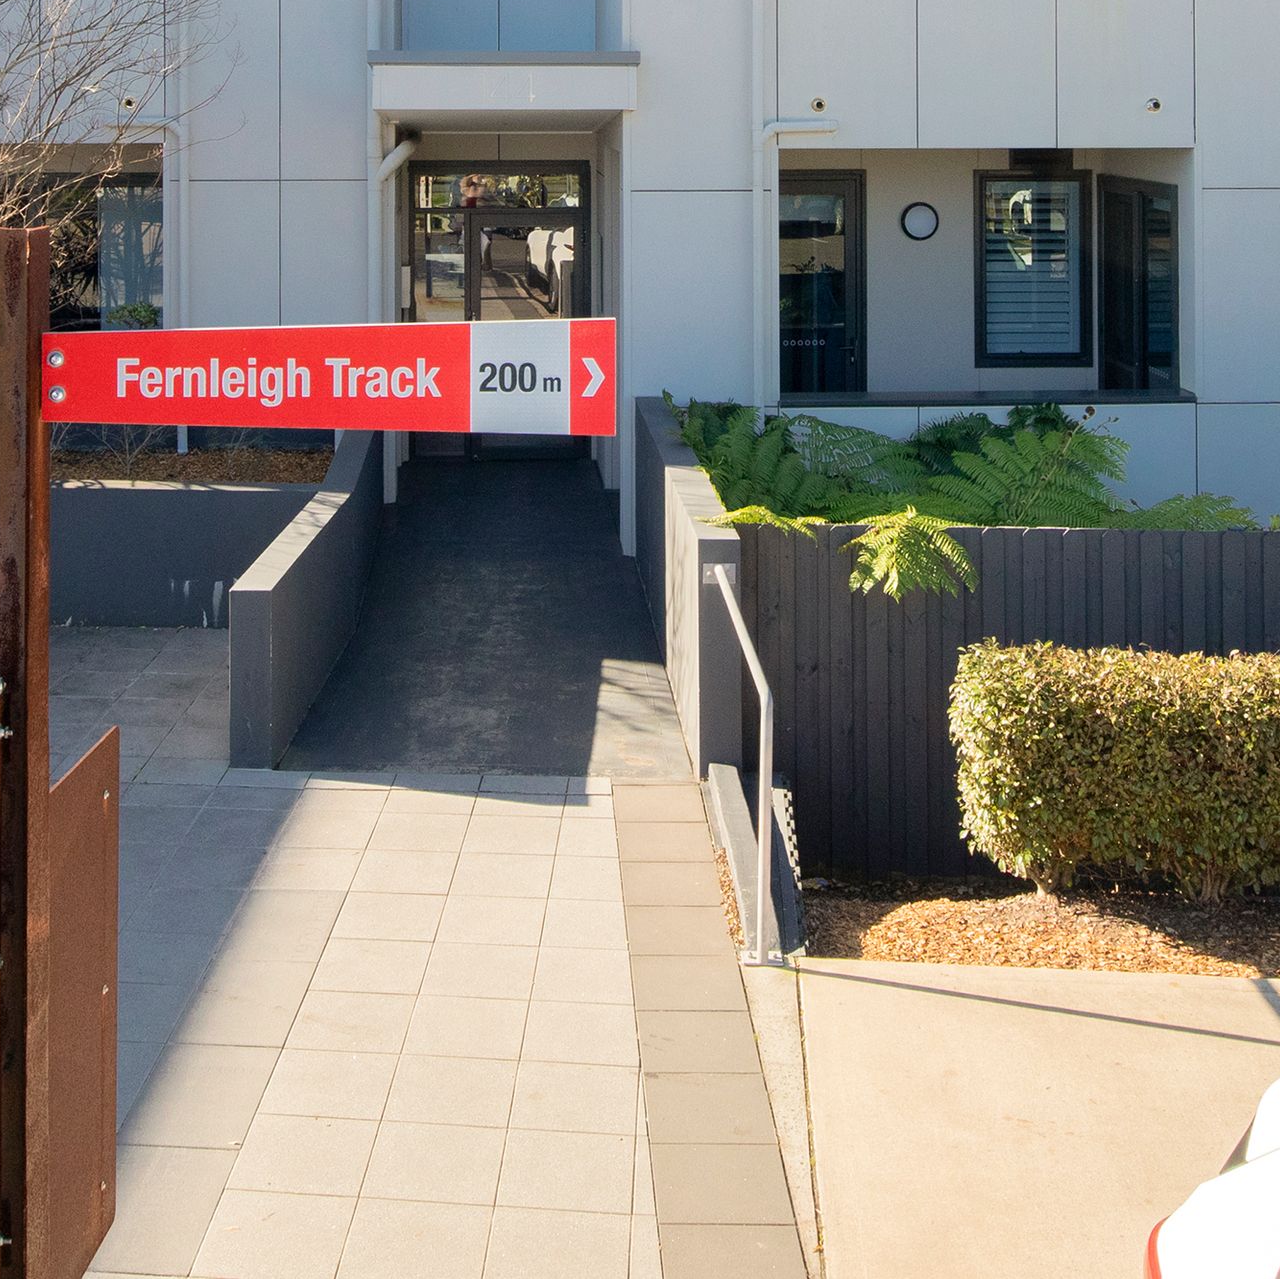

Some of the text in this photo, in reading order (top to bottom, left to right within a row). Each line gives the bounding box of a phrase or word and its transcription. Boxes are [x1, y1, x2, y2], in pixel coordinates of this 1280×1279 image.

[116, 357, 442, 408] Fernleigh Track
[478, 362, 562, 394] 200 m
